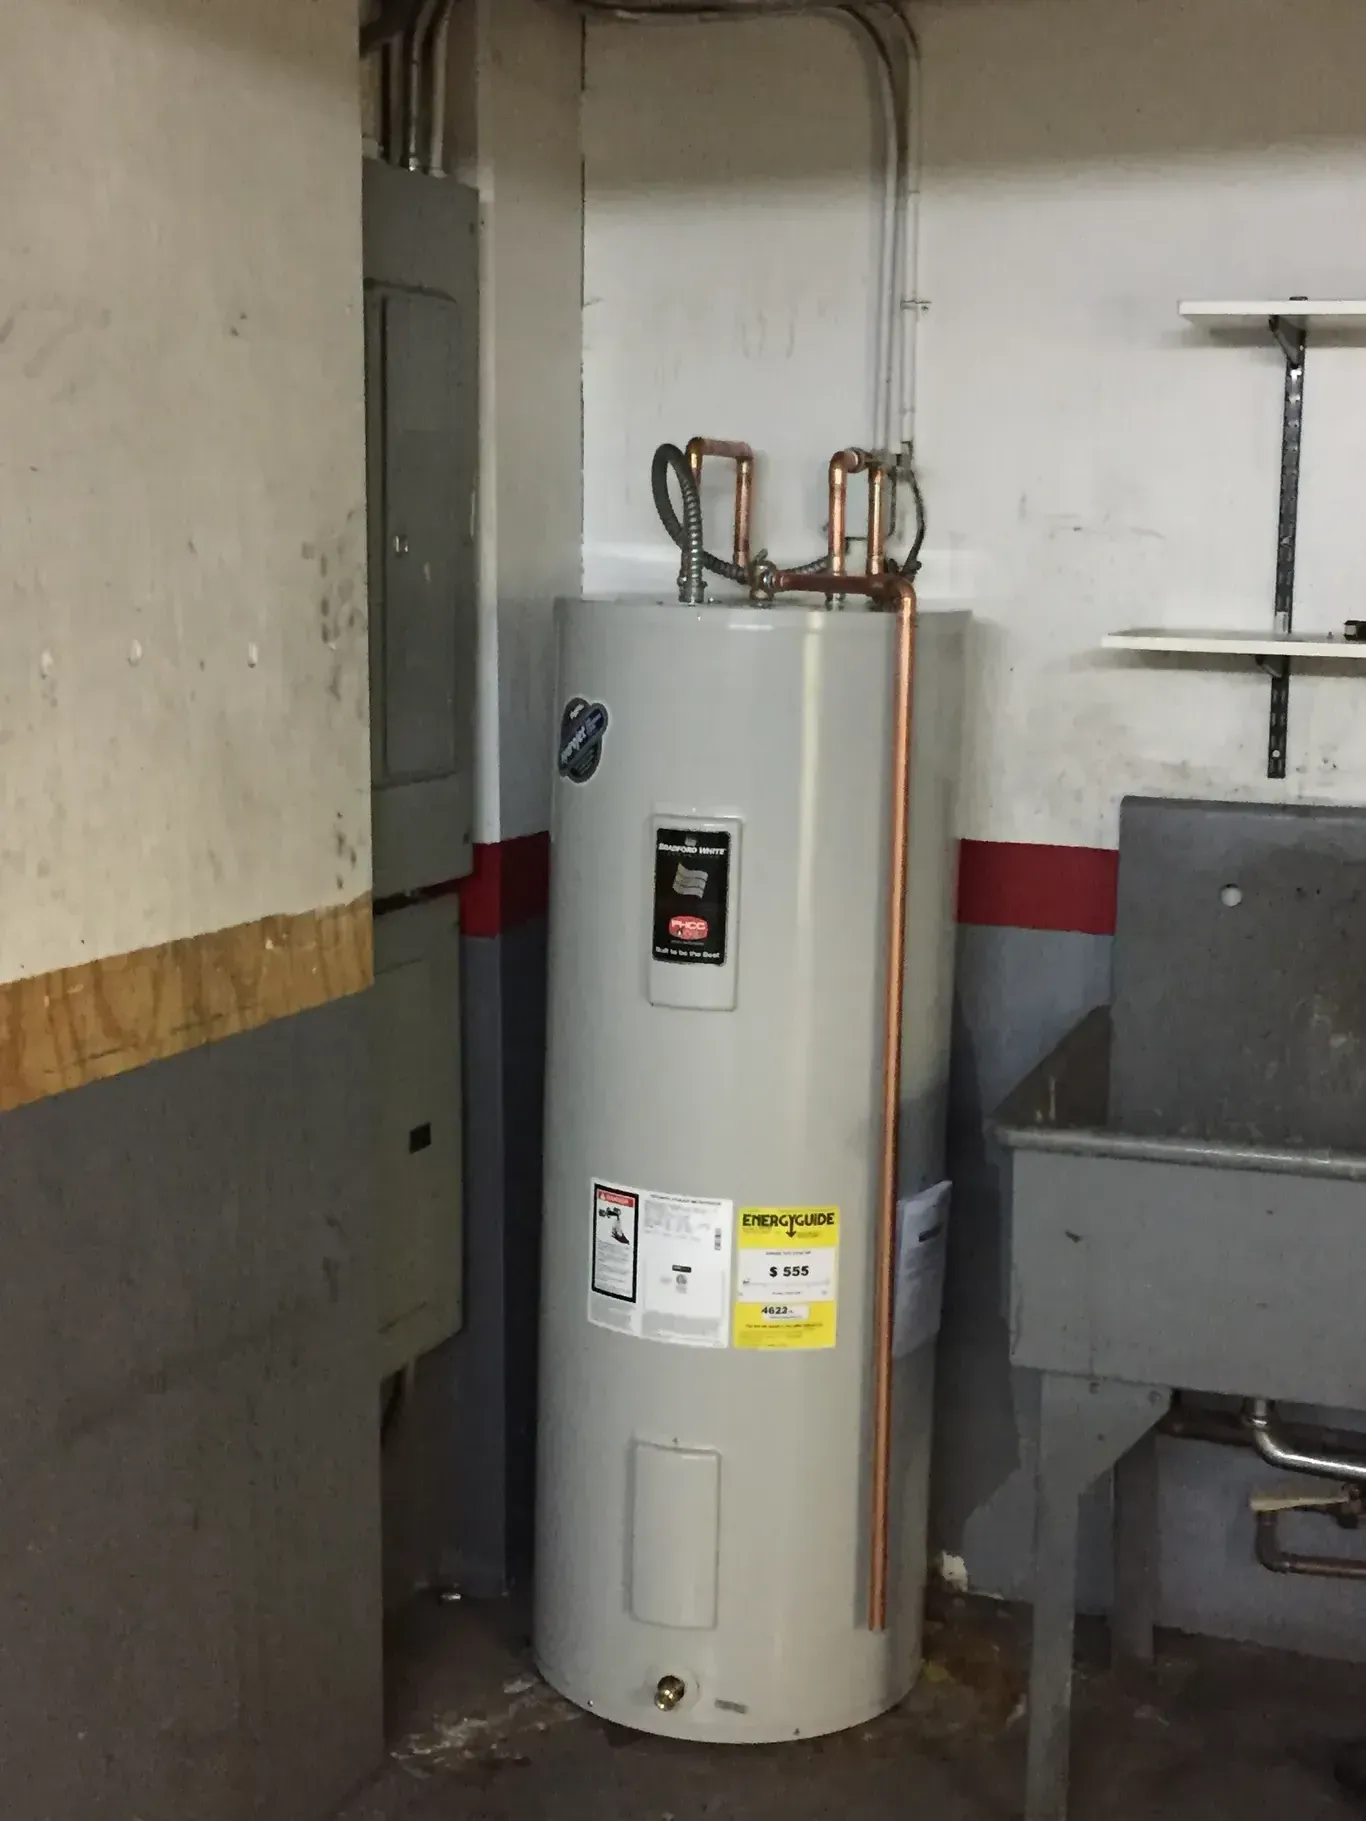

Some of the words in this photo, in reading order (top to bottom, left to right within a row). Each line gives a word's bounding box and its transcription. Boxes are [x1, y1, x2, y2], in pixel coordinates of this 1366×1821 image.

[659, 843, 698, 854] BRADFORD
[699, 847, 727, 855] WHITE
[671, 920, 706, 930] PHCC
[656, 946, 669, 954] Built
[769, 1266, 778, 1278] $
[783, 1265, 810, 1277] 555
